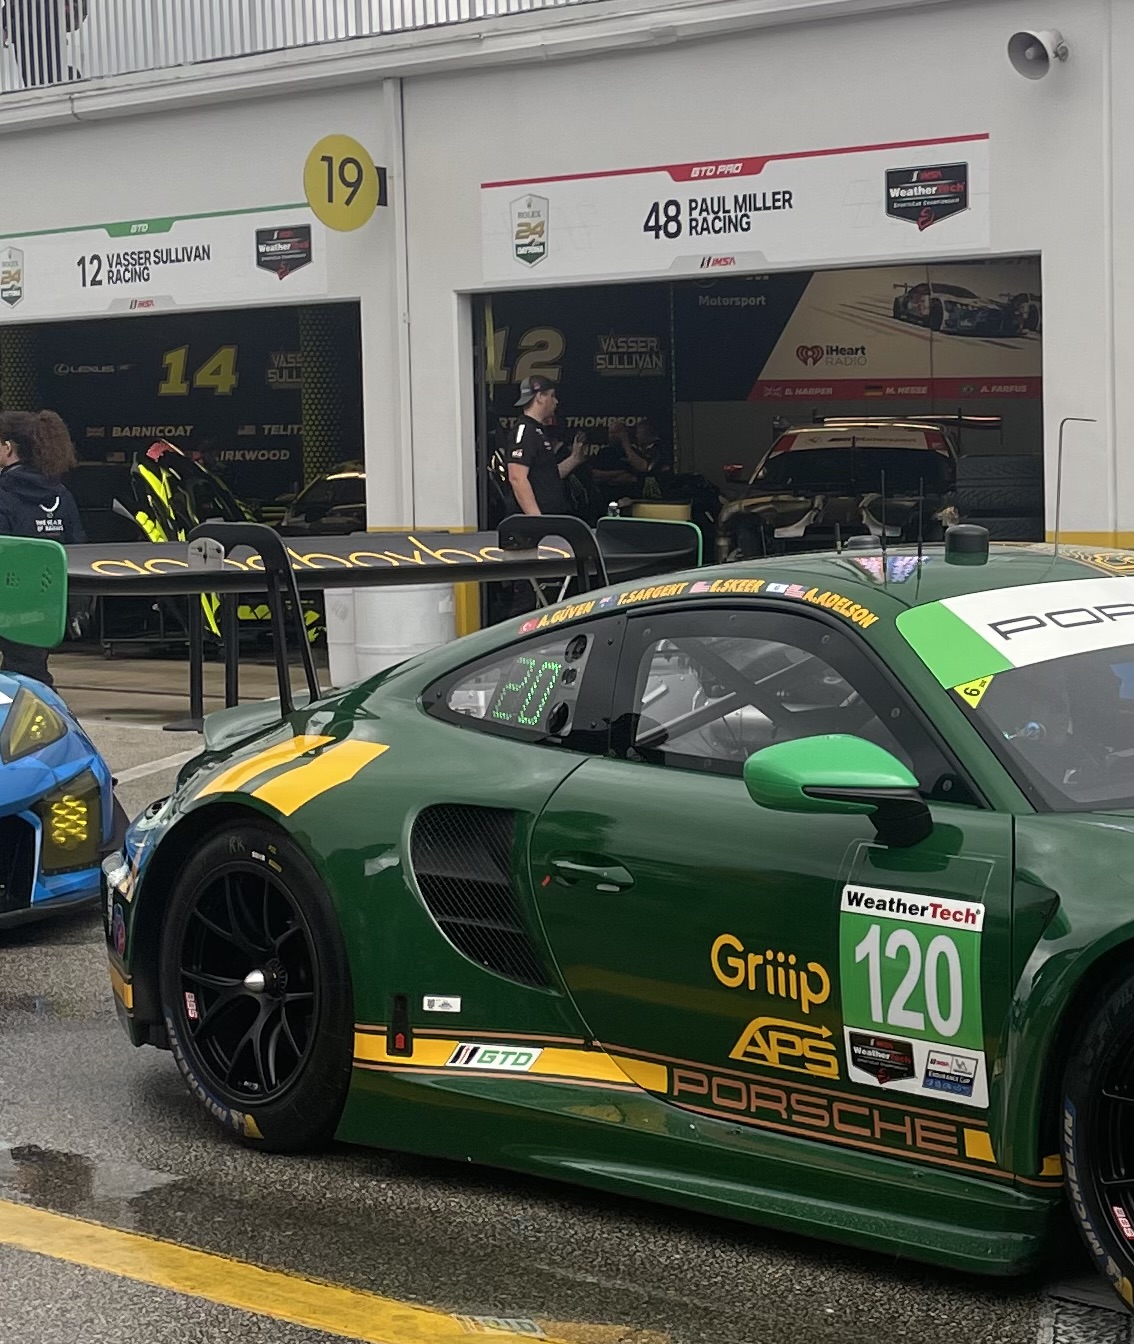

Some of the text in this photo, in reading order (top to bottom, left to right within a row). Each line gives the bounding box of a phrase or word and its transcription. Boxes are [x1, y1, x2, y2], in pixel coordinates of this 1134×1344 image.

[320, 156, 363, 207] 19
[643, 190, 793, 239] 48 PAUL MILLER
[689, 213, 751, 236] RACING
[515, 220, 545, 240] 24
[77, 244, 211, 287] 12 VASSER SULLIVAN
[107, 267, 150, 284] RACING
[699, 295, 766, 307] Motorsport
[602, 332, 660, 352] VASSER
[826, 345, 866, 356] iHeart
[158, 345, 238, 396] 14
[595, 353, 663, 370] SULLIVAN
[826, 356, 867, 366] RADIO
[112, 425, 193, 437] BARNICOAT
[847, 891, 977, 925] WeatherTech
[711, 933, 831, 1014] Griiip
[855, 924, 963, 1037] 120
[477, 1049, 533, 1066] GTD
[729, 1018, 840, 1079] APS
[673, 1067, 959, 1156] PORSCHE
[1064, 1110, 1105, 1256] MICHELIN
